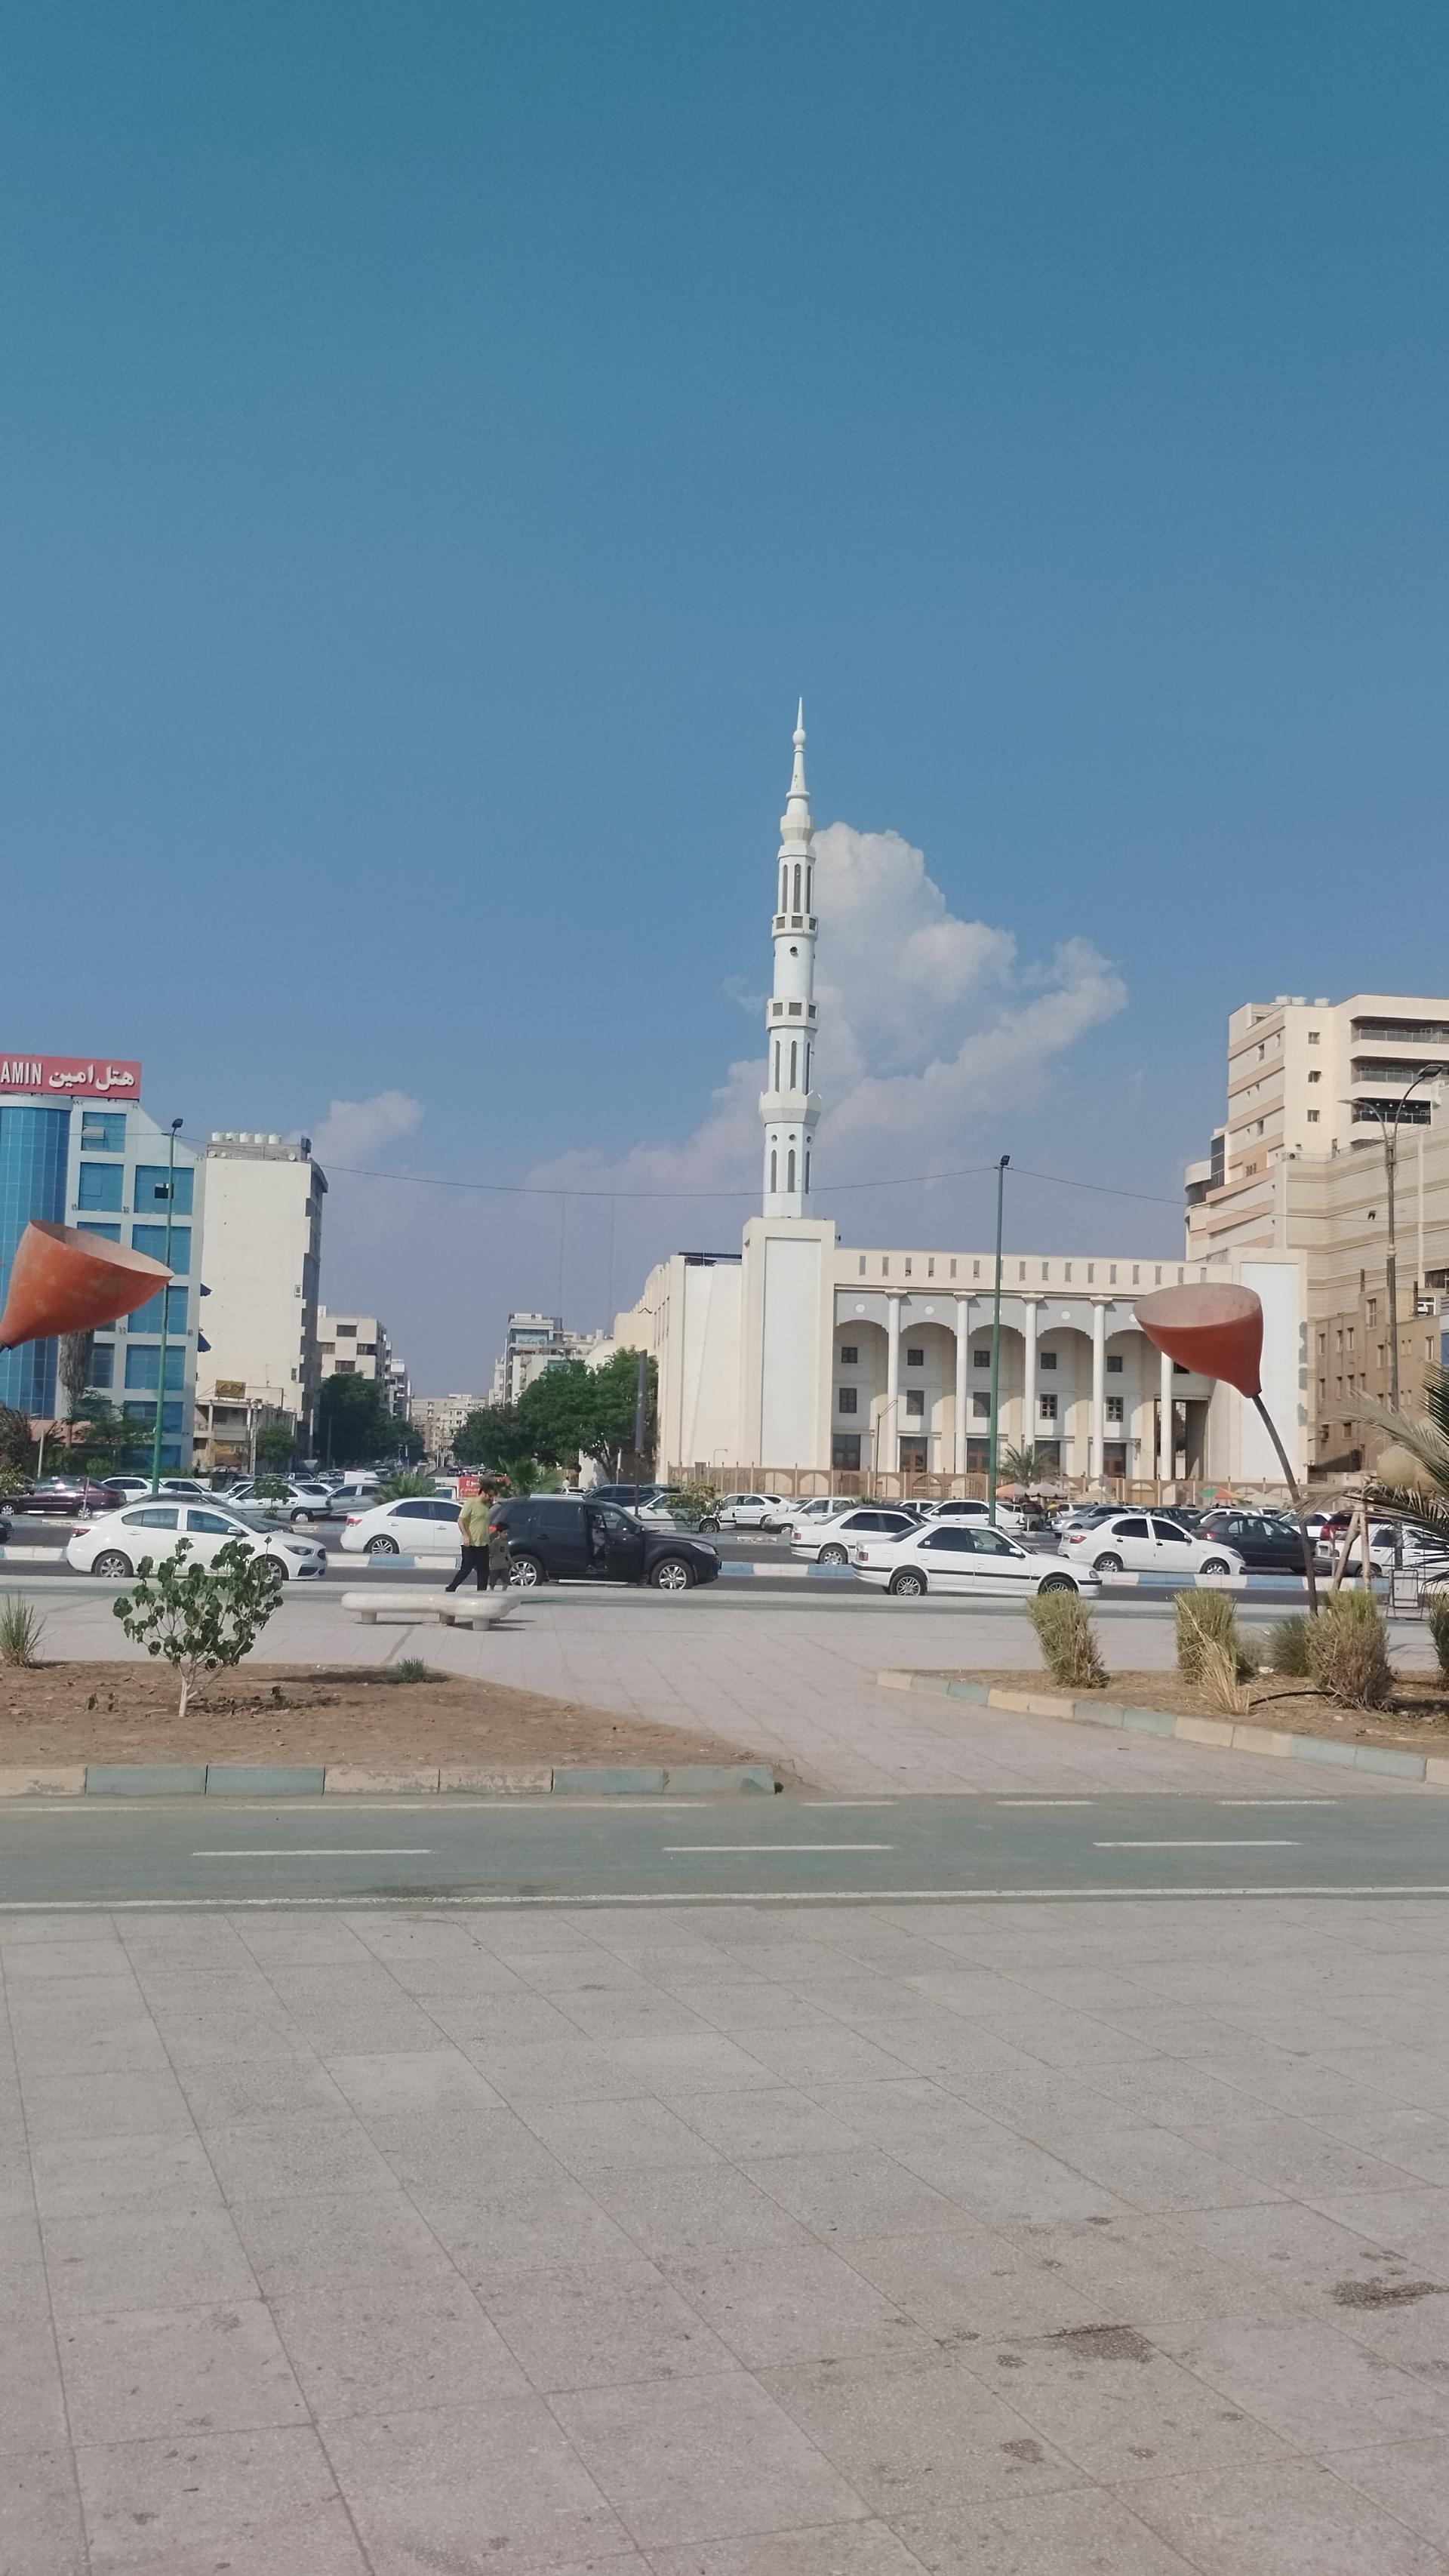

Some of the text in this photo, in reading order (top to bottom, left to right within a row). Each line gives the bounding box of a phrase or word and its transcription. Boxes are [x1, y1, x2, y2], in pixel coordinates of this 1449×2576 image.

[1, 1061, 42, 1085] AMIN
[49, 1064, 134, 1091] هتل امین
